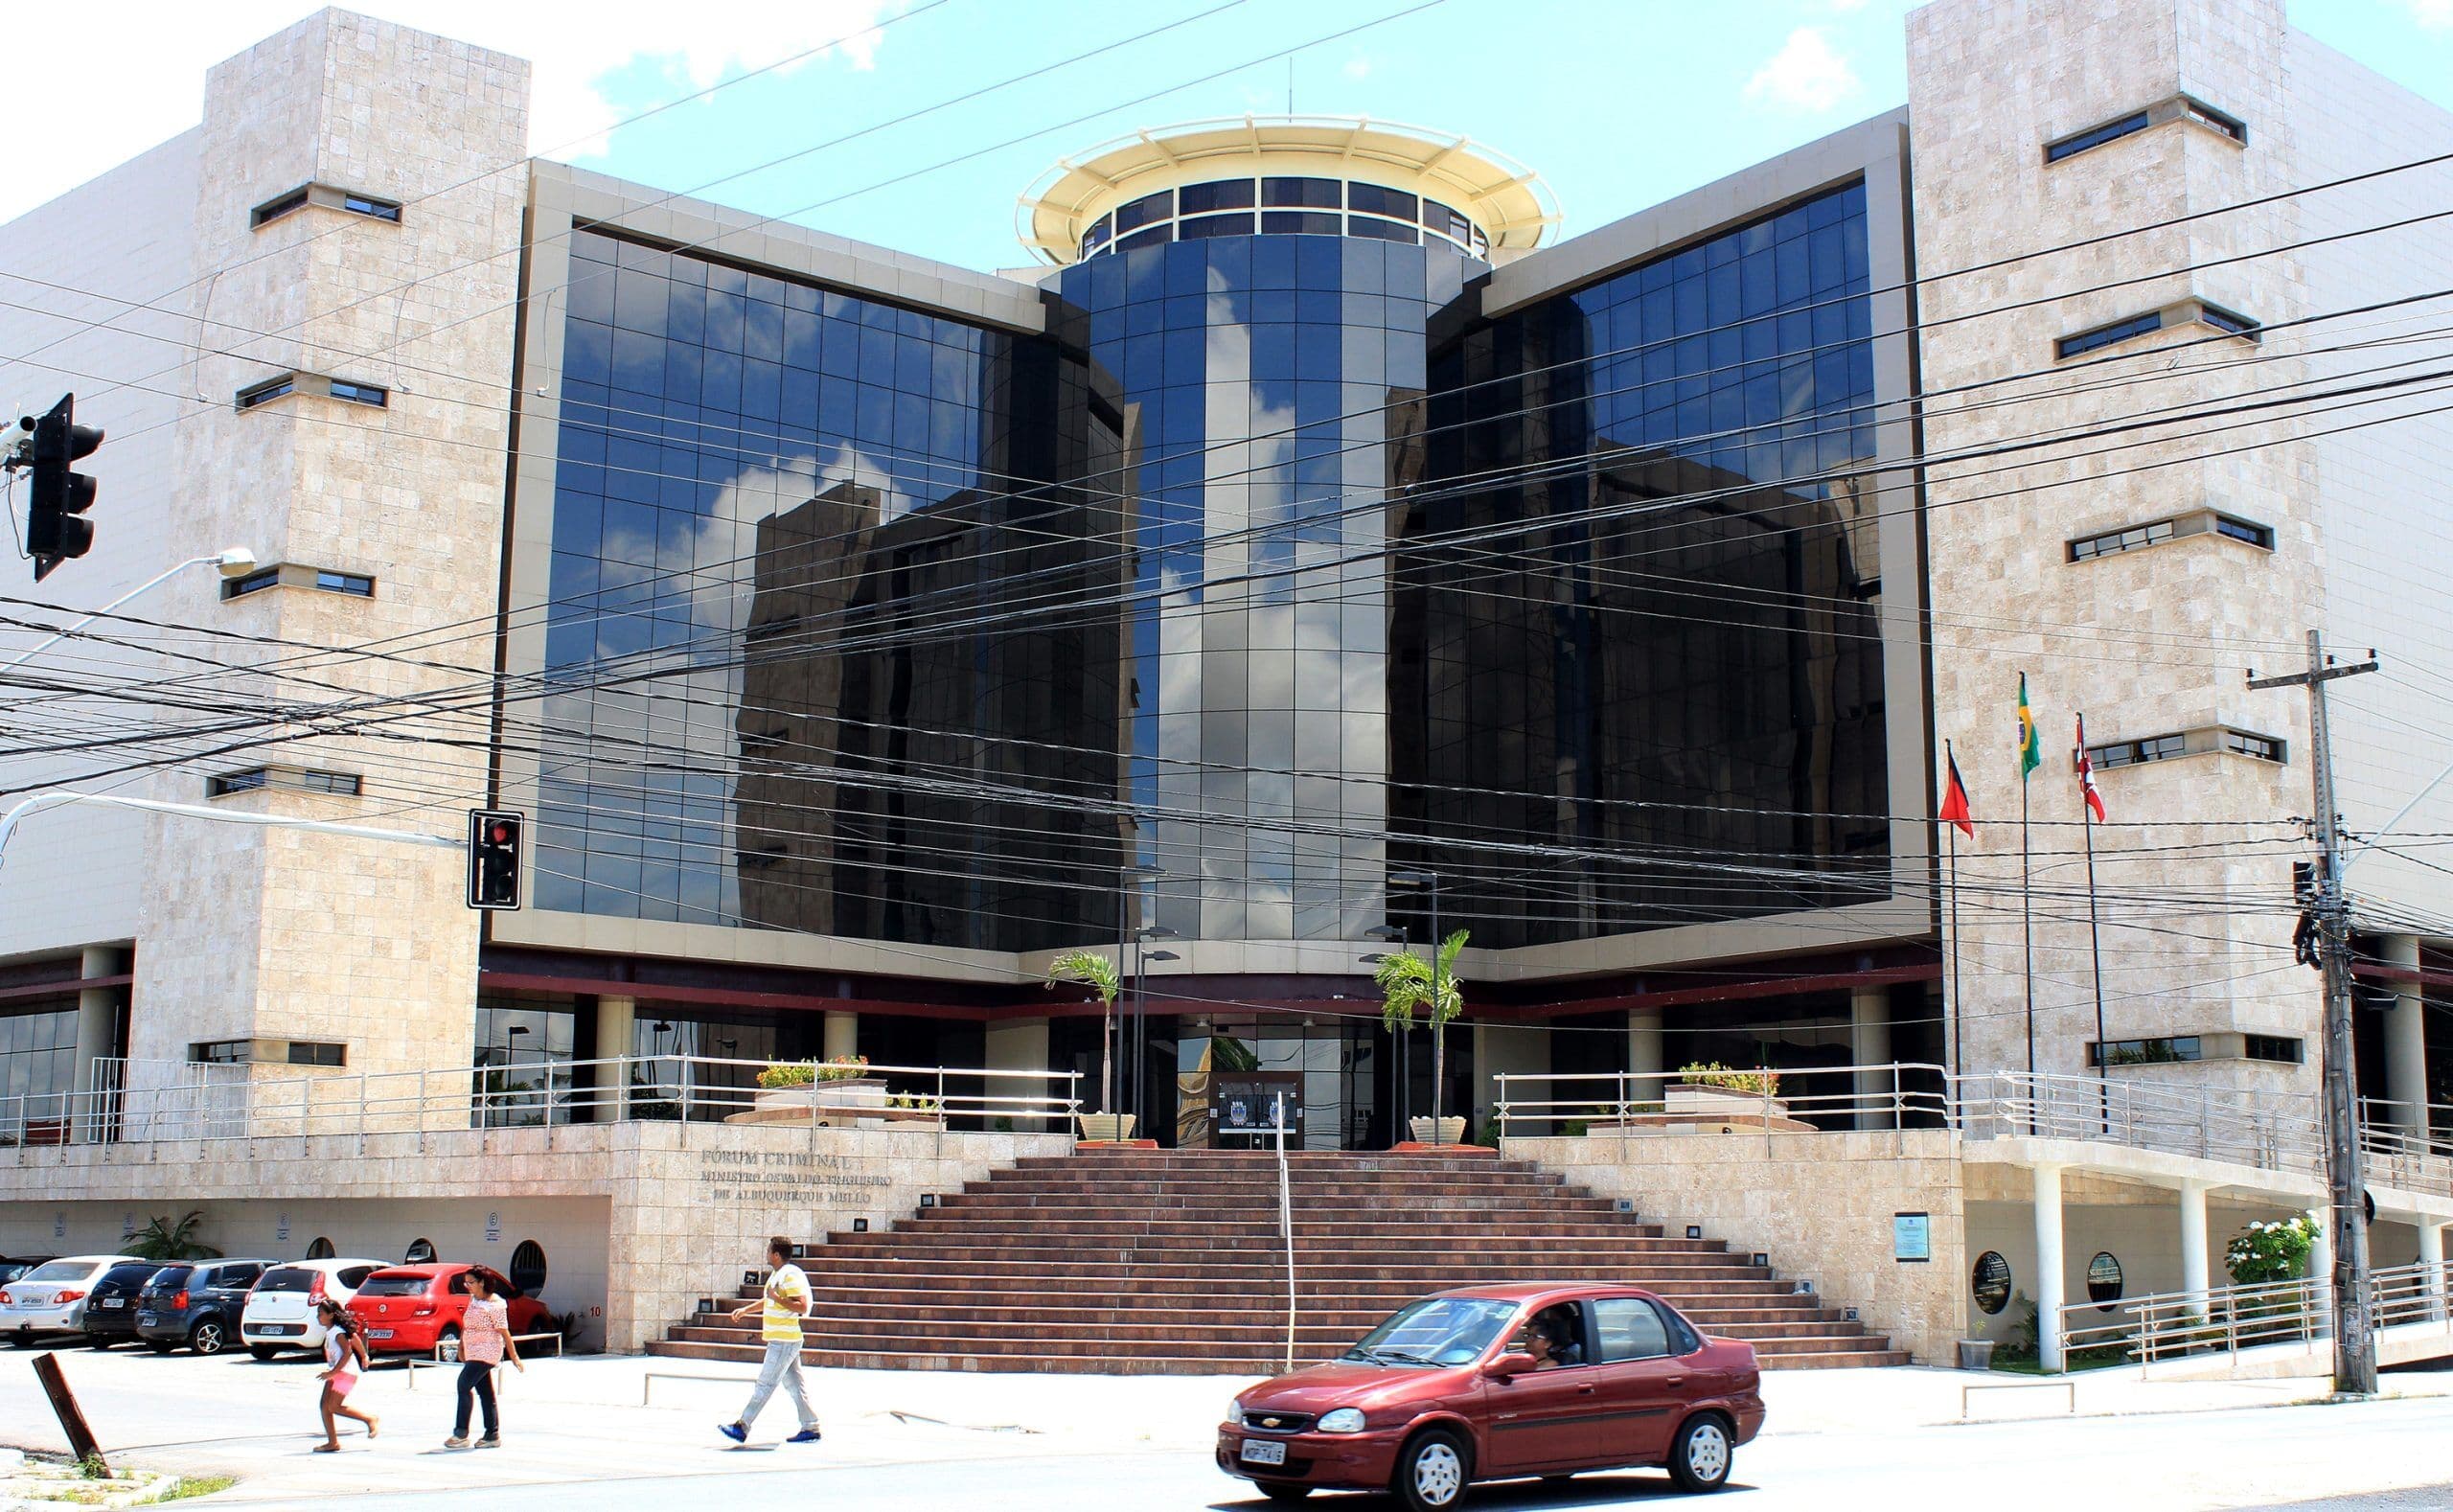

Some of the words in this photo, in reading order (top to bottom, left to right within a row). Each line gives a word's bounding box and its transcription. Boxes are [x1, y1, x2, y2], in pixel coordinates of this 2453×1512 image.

[764, 1152, 851, 1170] CRIMINAL
[700, 1170, 761, 1182] MINISTRO
[766, 1173, 821, 1184] OSWALDO
[713, 1189, 730, 1201] DE
[735, 1189, 823, 1203] ALBUQUERQUE
[828, 1192, 872, 1203] MELLO
[590, 1306, 601, 1317] 10
